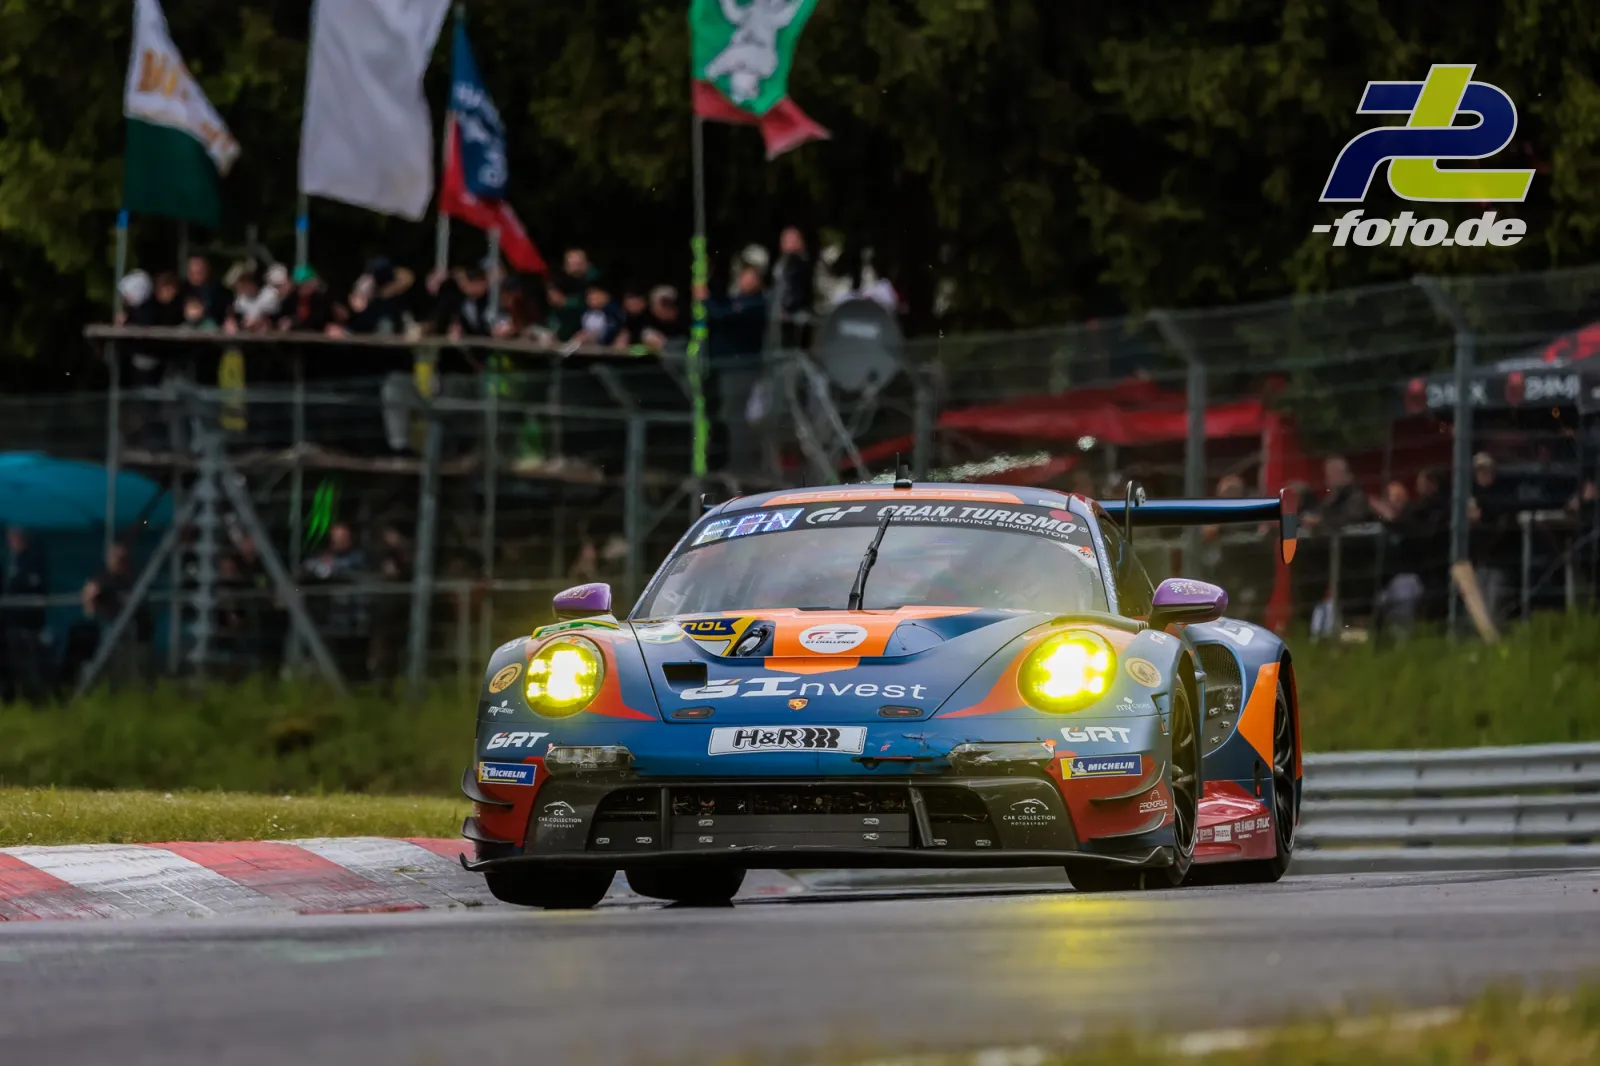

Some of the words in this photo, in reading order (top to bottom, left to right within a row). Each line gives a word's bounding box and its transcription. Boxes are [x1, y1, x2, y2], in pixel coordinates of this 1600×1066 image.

[876, 505, 955, 517] GRAN
[960, 507, 1077, 534] TURISMO
[941, 517, 992, 526] DRIVING
[994, 522, 1069, 540] SIMULATOR
[486, 731, 549, 750] GRT
[733, 728, 802, 749] H&R
[1060, 726, 1131, 743] GRT
[489, 769, 527, 779] MICHELIN
[1088, 761, 1135, 771] MICHELIN
[1023, 806, 1036, 814] CC
